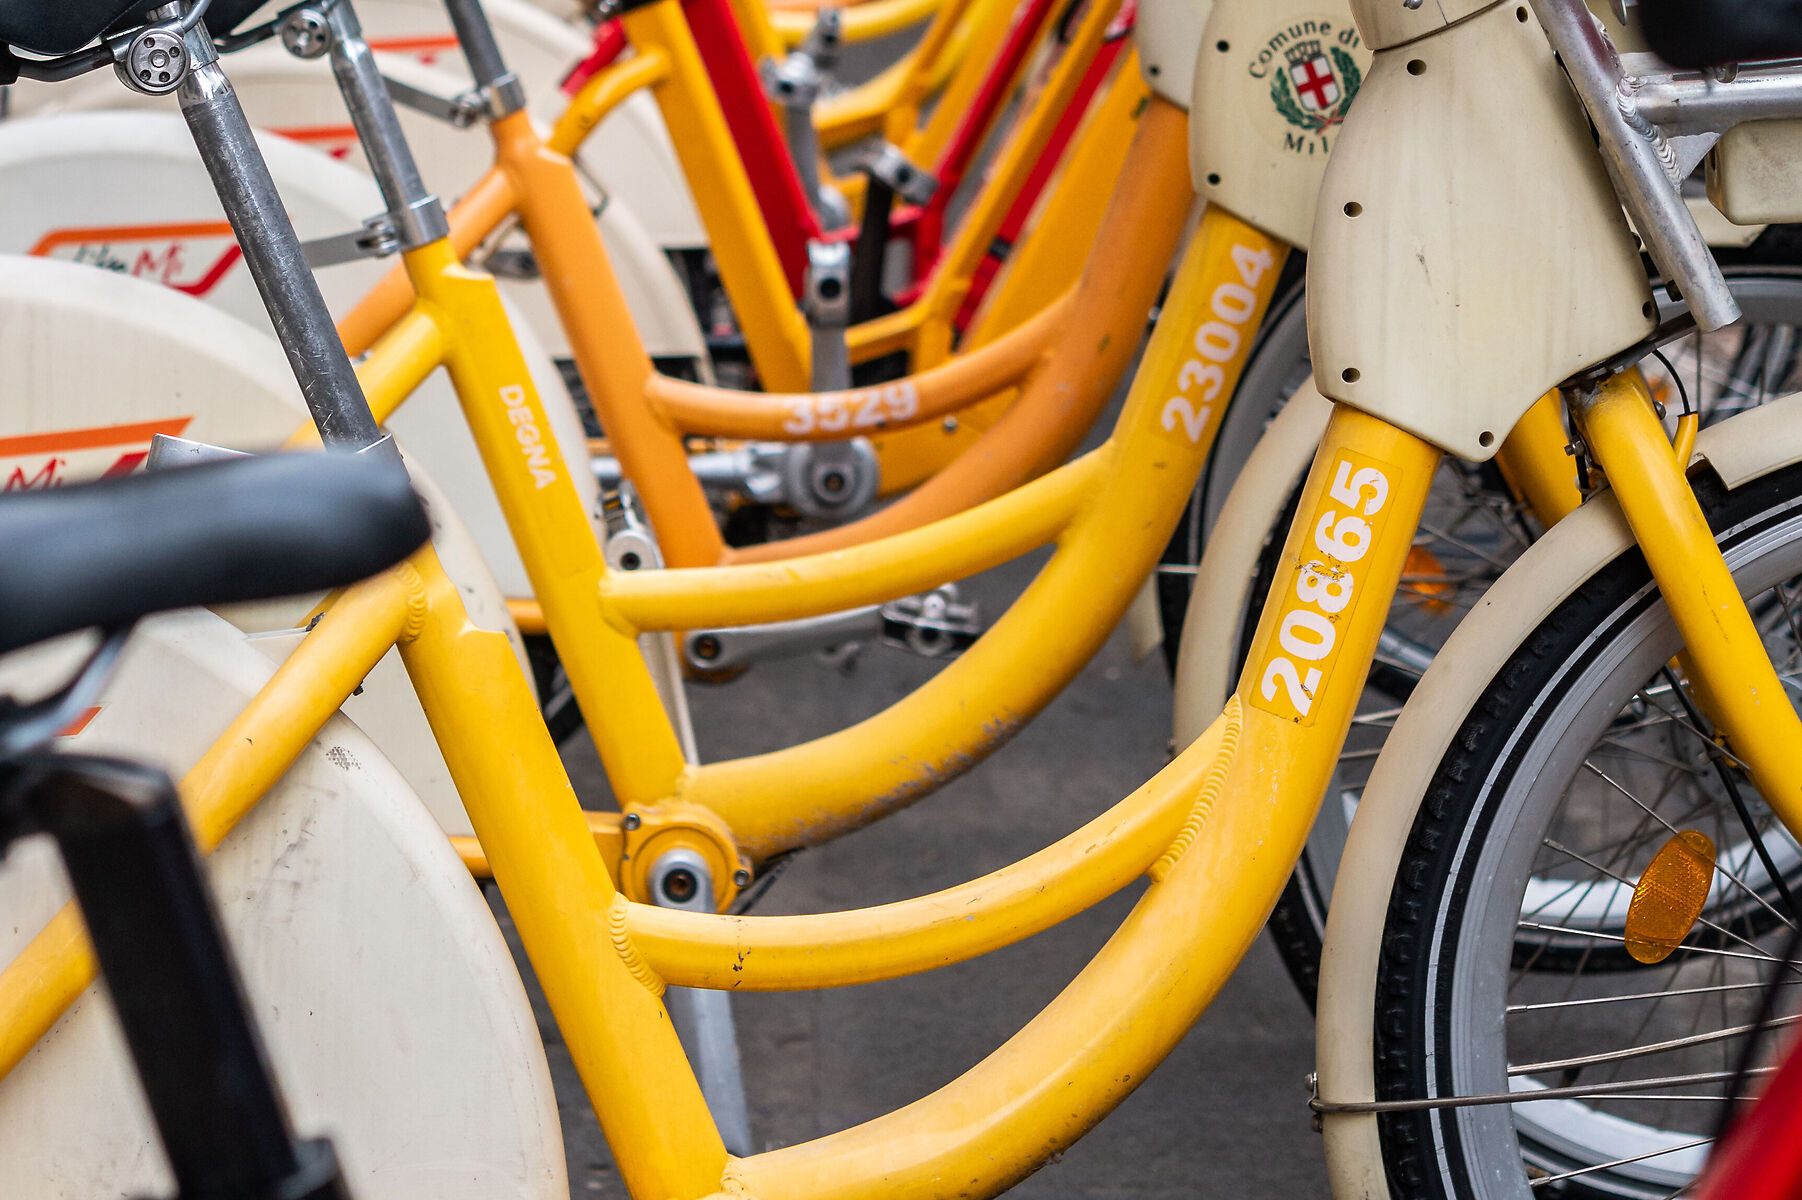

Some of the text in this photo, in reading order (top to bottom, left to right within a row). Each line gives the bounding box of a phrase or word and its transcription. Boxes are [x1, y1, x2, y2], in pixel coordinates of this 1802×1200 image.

[1248, 21, 1360, 79] Comune di
[1161, 243, 1275, 443] 23004
[498, 384, 557, 490] DEGNA
[782, 380, 919, 435] 3529
[1260, 460, 1389, 717] 20865
